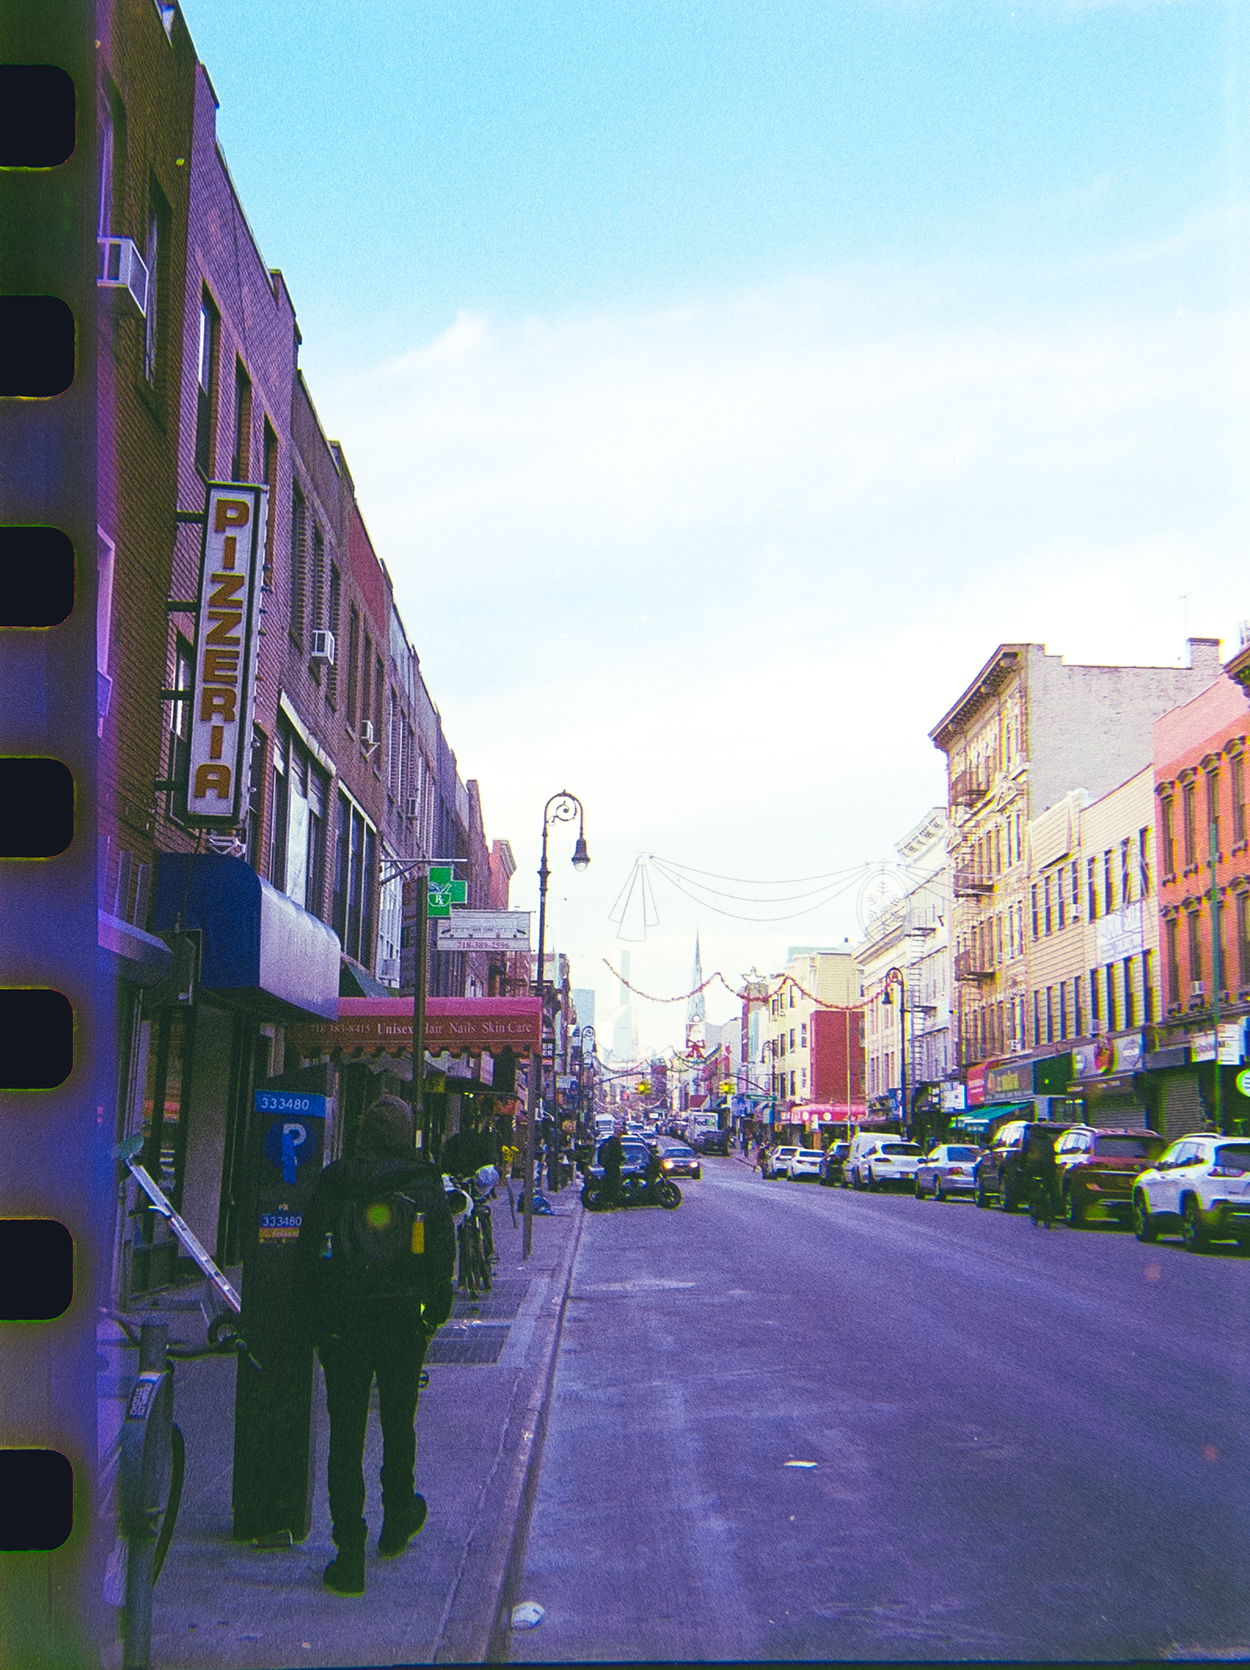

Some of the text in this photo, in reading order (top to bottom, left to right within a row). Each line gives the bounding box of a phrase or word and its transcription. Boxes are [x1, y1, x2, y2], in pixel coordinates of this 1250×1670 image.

[194, 498, 250, 799] PIZZERIA
[425, 1022, 444, 1034] air
[450, 1022, 477, 1034] Nails
[482, 1021, 505, 1033] Skin
[508, 1022, 533, 1033] Care
[261, 1097, 310, 1111] 333480
[262, 1216, 303, 1227] 333480
